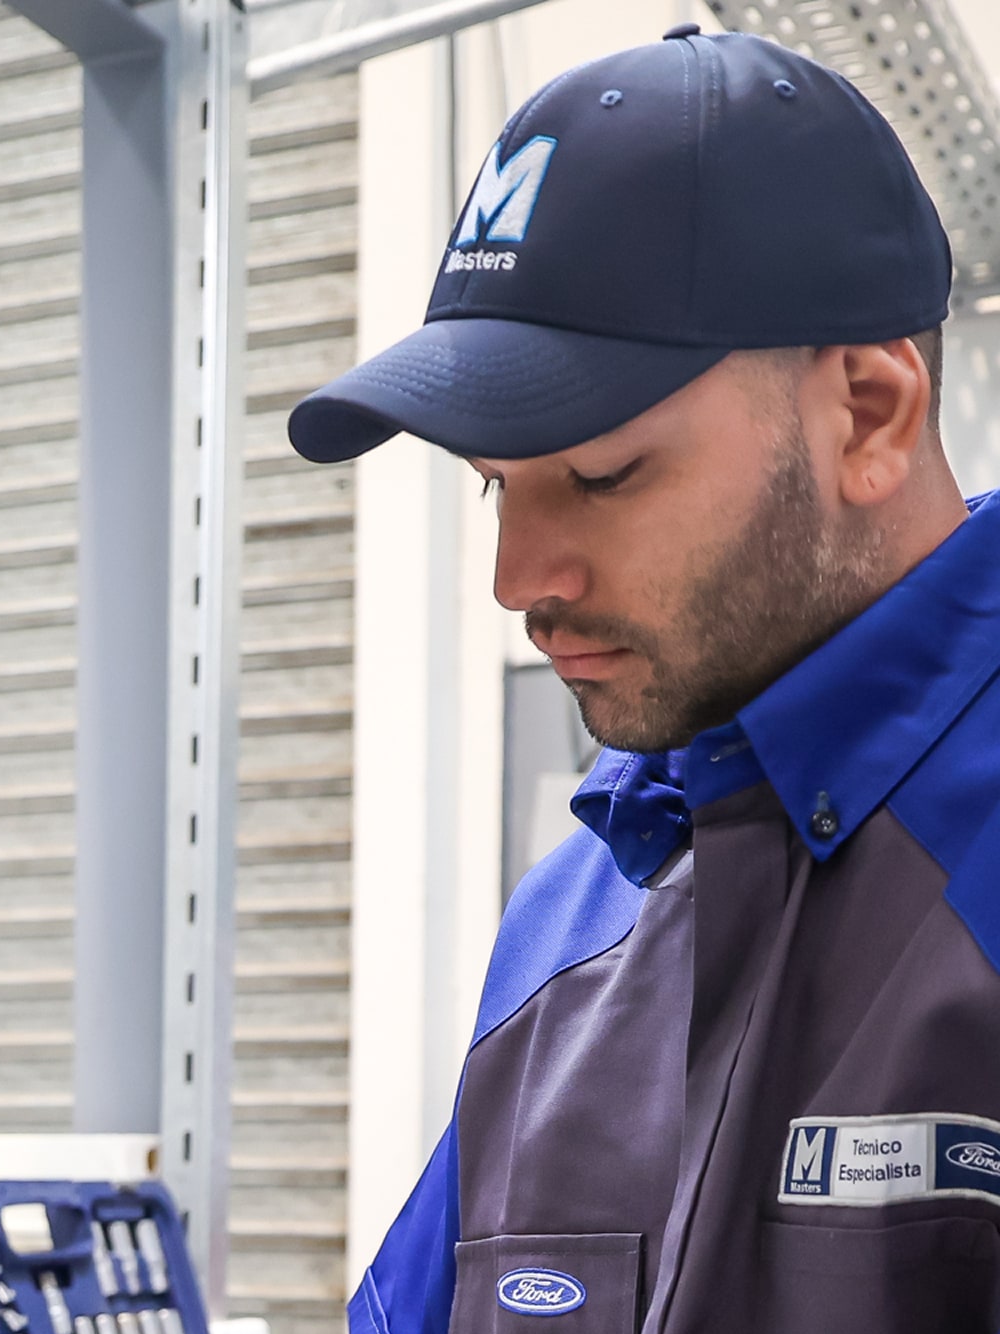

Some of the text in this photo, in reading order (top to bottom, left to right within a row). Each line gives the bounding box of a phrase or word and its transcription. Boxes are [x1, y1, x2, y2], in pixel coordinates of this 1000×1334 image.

[455, 135, 559, 247] M
[791, 1128, 827, 1181] M
[838, 1162, 922, 1184] Especialista
[790, 1182, 822, 1194] Masters
[512, 1278, 565, 1304] Ford
